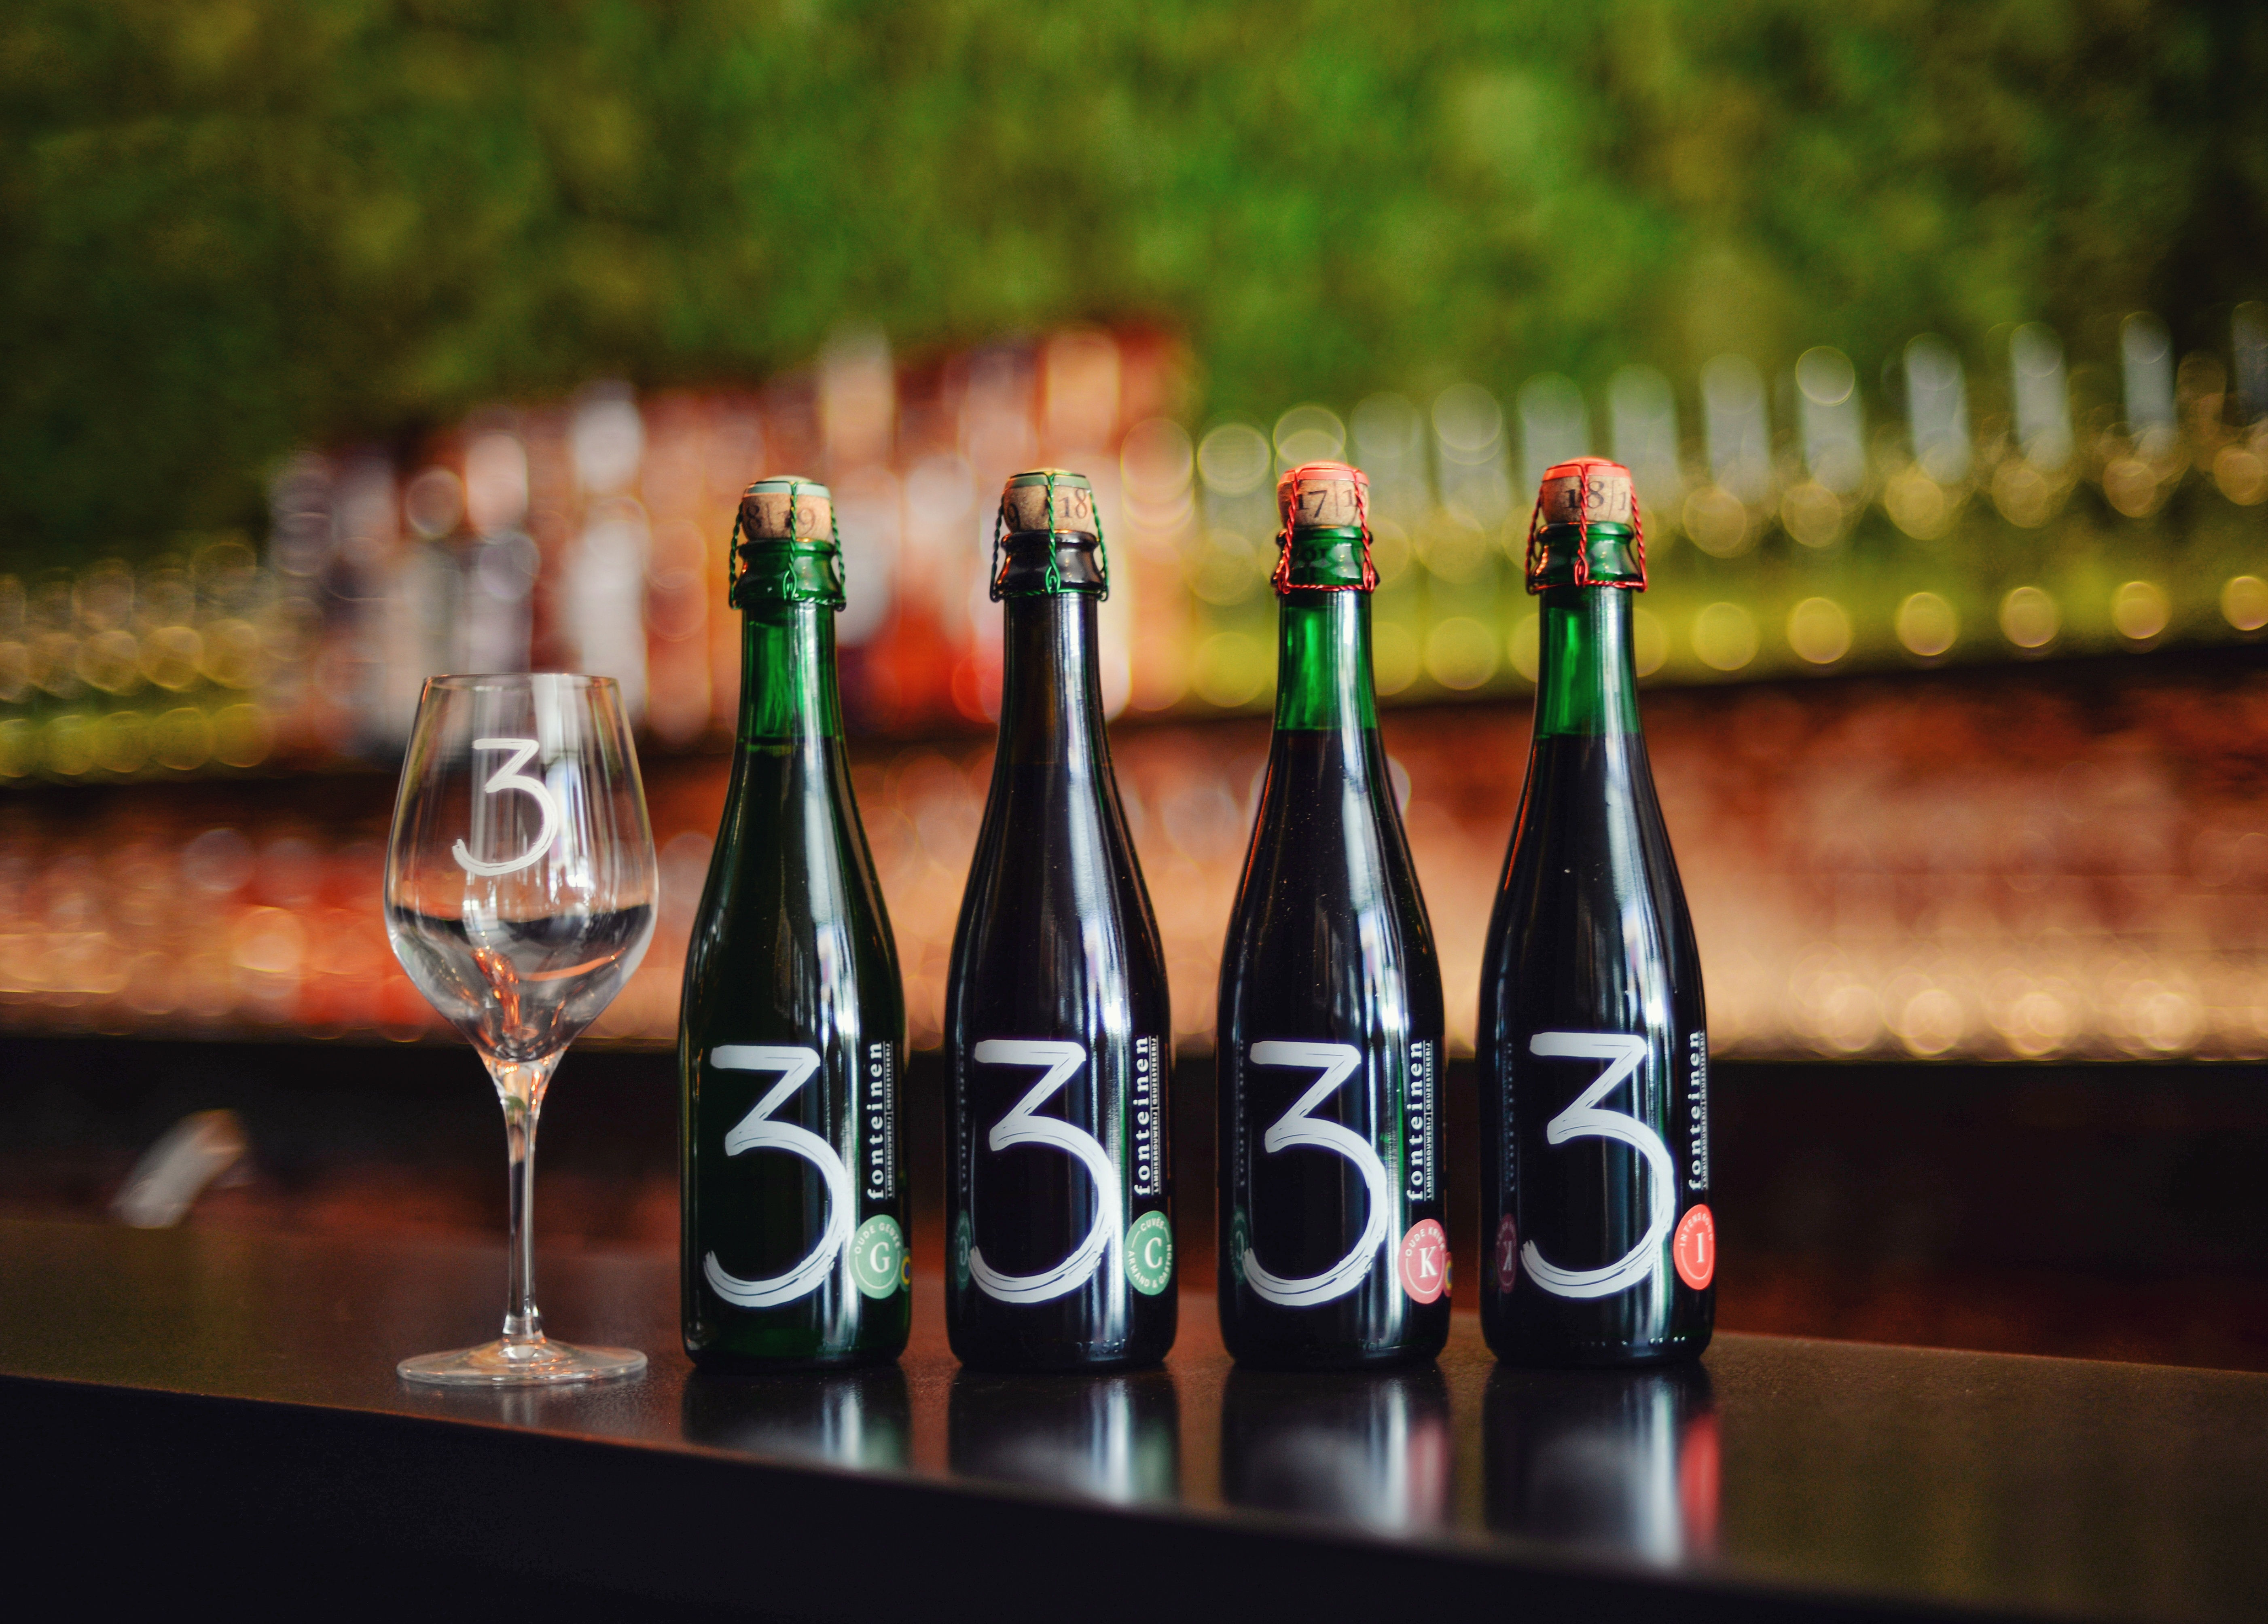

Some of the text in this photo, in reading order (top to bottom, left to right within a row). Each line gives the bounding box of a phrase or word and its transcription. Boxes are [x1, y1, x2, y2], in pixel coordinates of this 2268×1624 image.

[451, 738, 558, 876] 3
[703, 1045, 849, 1307] 3
[866, 1042, 884, 1200] fonteinen
[969, 1039, 1119, 1303] 3
[1133, 1037, 1151, 1196] fonteinen
[1243, 1040, 1389, 1306] 3
[1406, 1042, 1424, 1201] fonteinen
[1520, 1032, 1675, 1298] 3
[1687, 1032, 1701, 1190] fonteinen
[854, 1225, 876, 1254] OUDE
[870, 1241, 890, 1273] G
[1128, 1250, 1150, 1287] ARMAND
[1152, 1279, 1158, 1288] &
[1140, 1216, 1165, 1231] CUVÉE
[1144, 1237, 1163, 1269] C
[1405, 1228, 1425, 1256] OUDE
[1419, 1246, 1438, 1277] K
